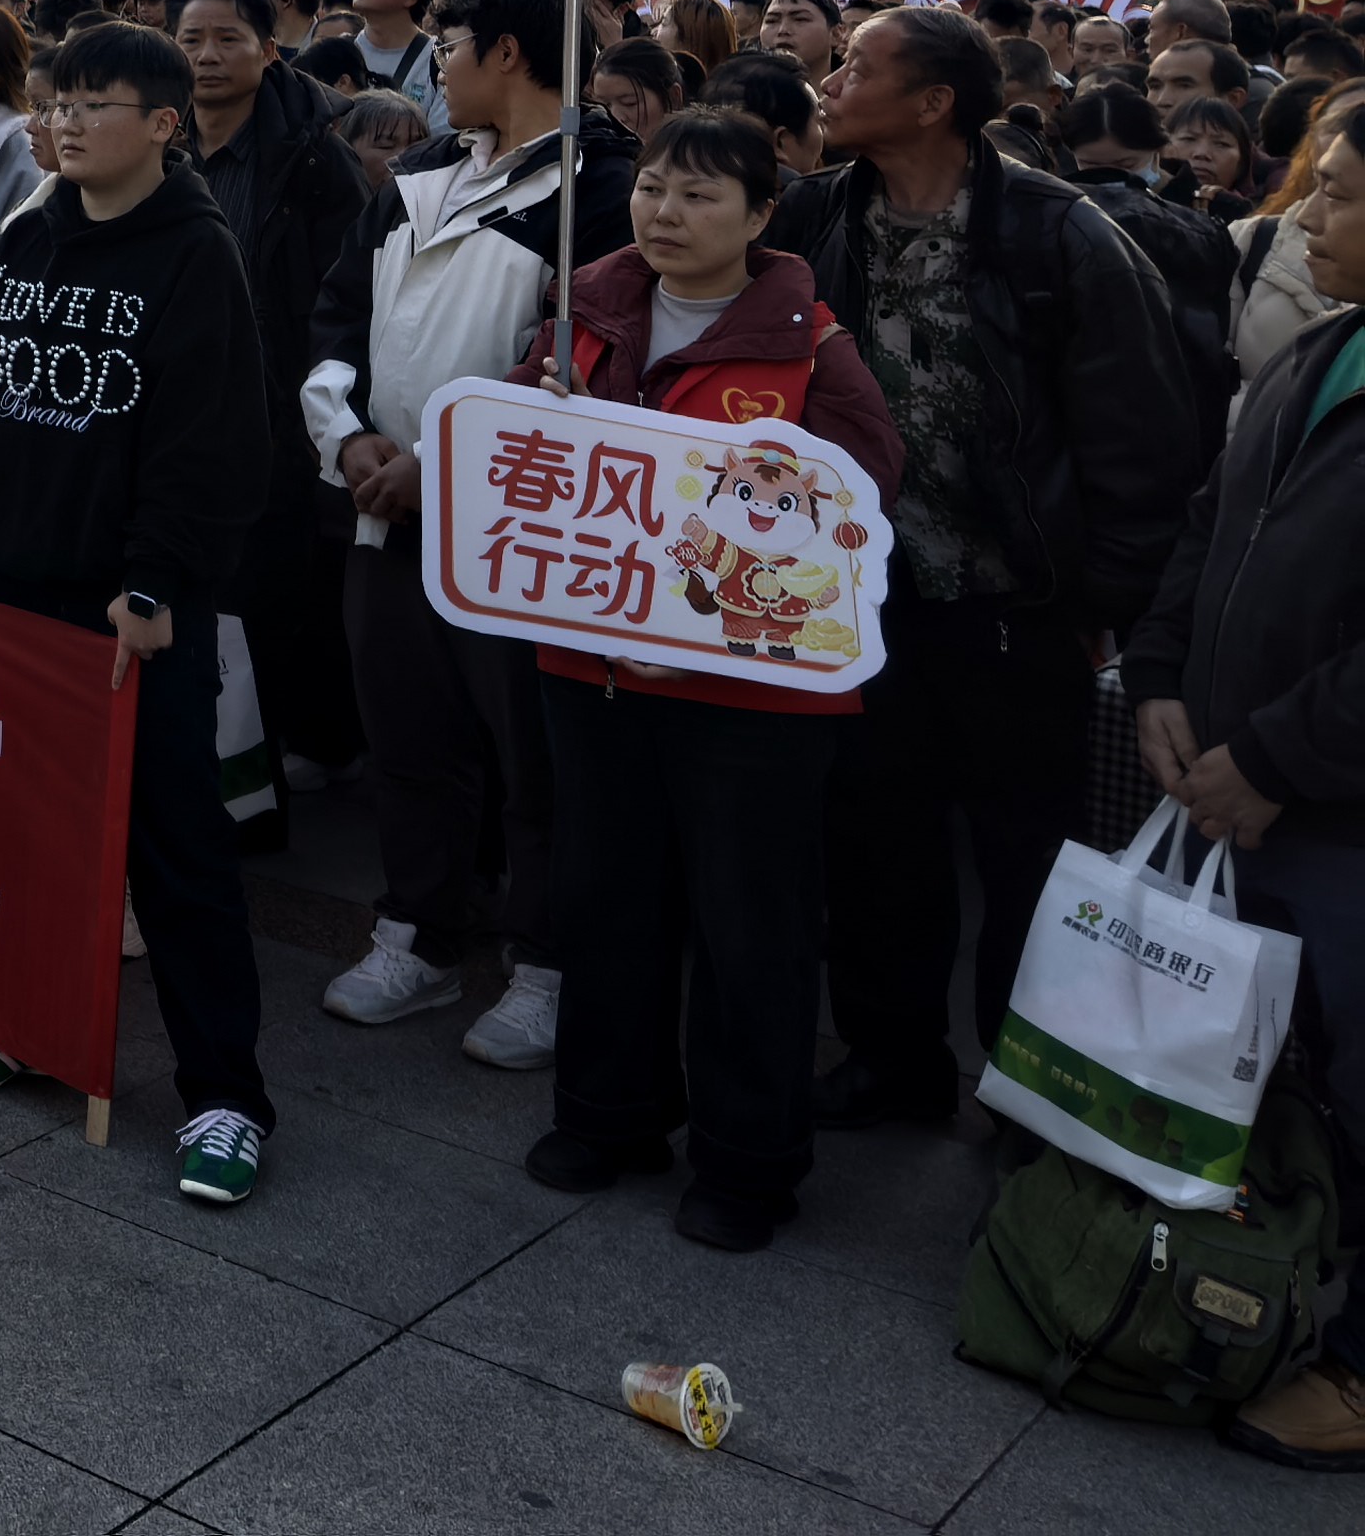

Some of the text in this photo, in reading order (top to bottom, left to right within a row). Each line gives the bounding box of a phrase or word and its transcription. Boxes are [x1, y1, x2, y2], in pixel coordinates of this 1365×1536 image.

[101, 290, 144, 337] IS
[488, 429, 665, 537] 春风
[479, 516, 656, 624] 行动
